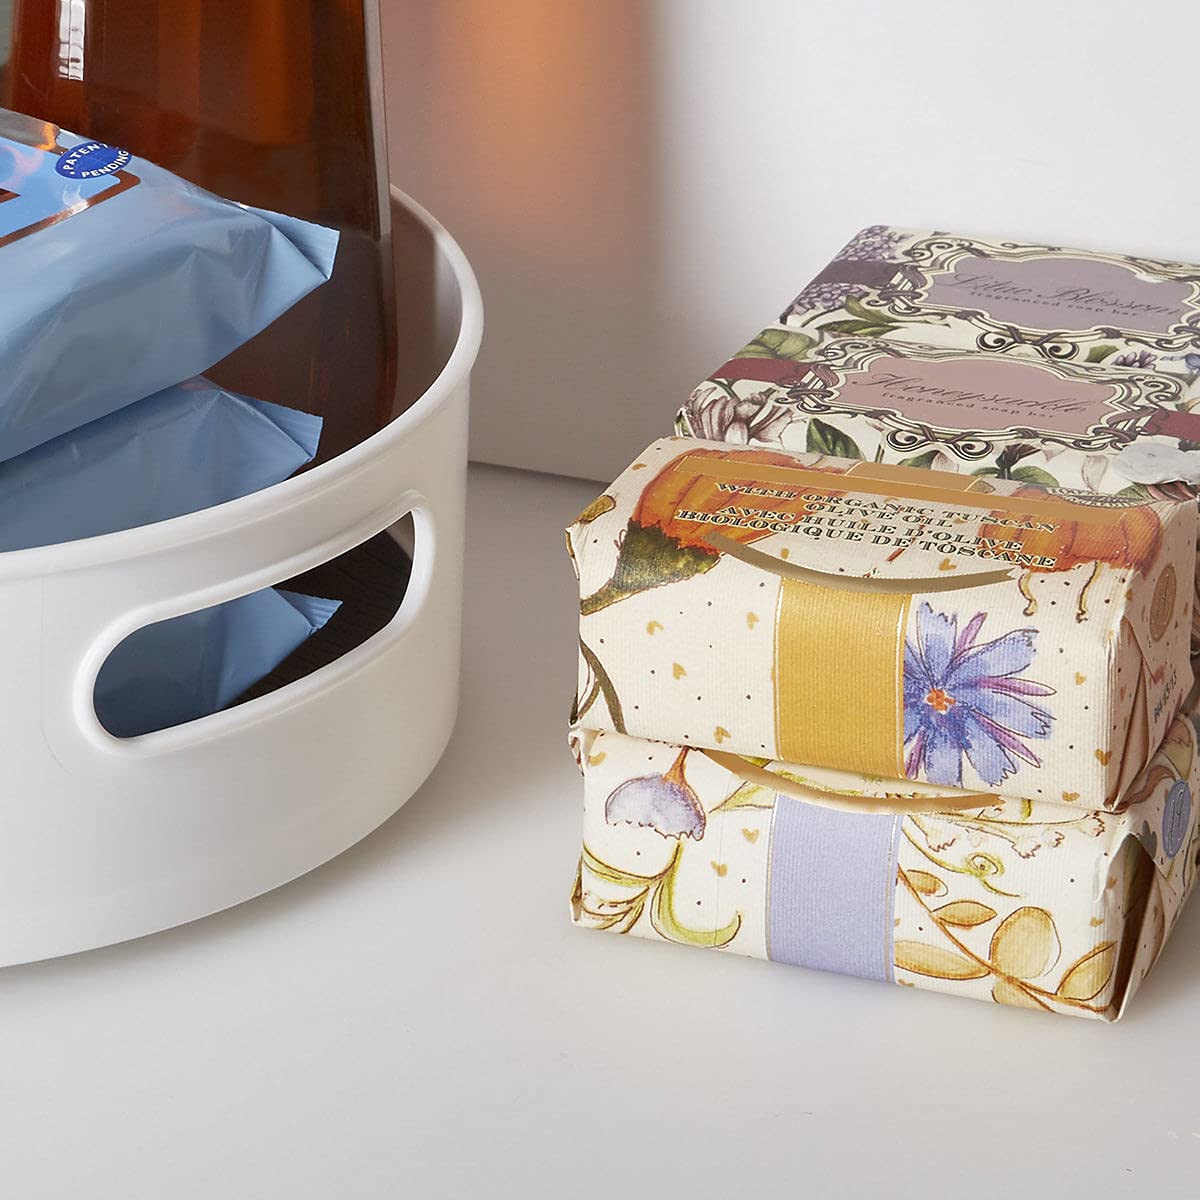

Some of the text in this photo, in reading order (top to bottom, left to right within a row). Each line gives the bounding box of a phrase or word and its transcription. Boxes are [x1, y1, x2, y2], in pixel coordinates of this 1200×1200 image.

[81, 149, 130, 178] PENDING
[715, 482, 1061, 533] WITH ORGANIC TUSCAN
[716, 506, 1025, 551] AVEC HUILE D'OLIVE
[804, 502, 954, 528] OLIVE OIL
[674, 509, 1057, 568] BIOLOGIQUE DE TOSCANE
